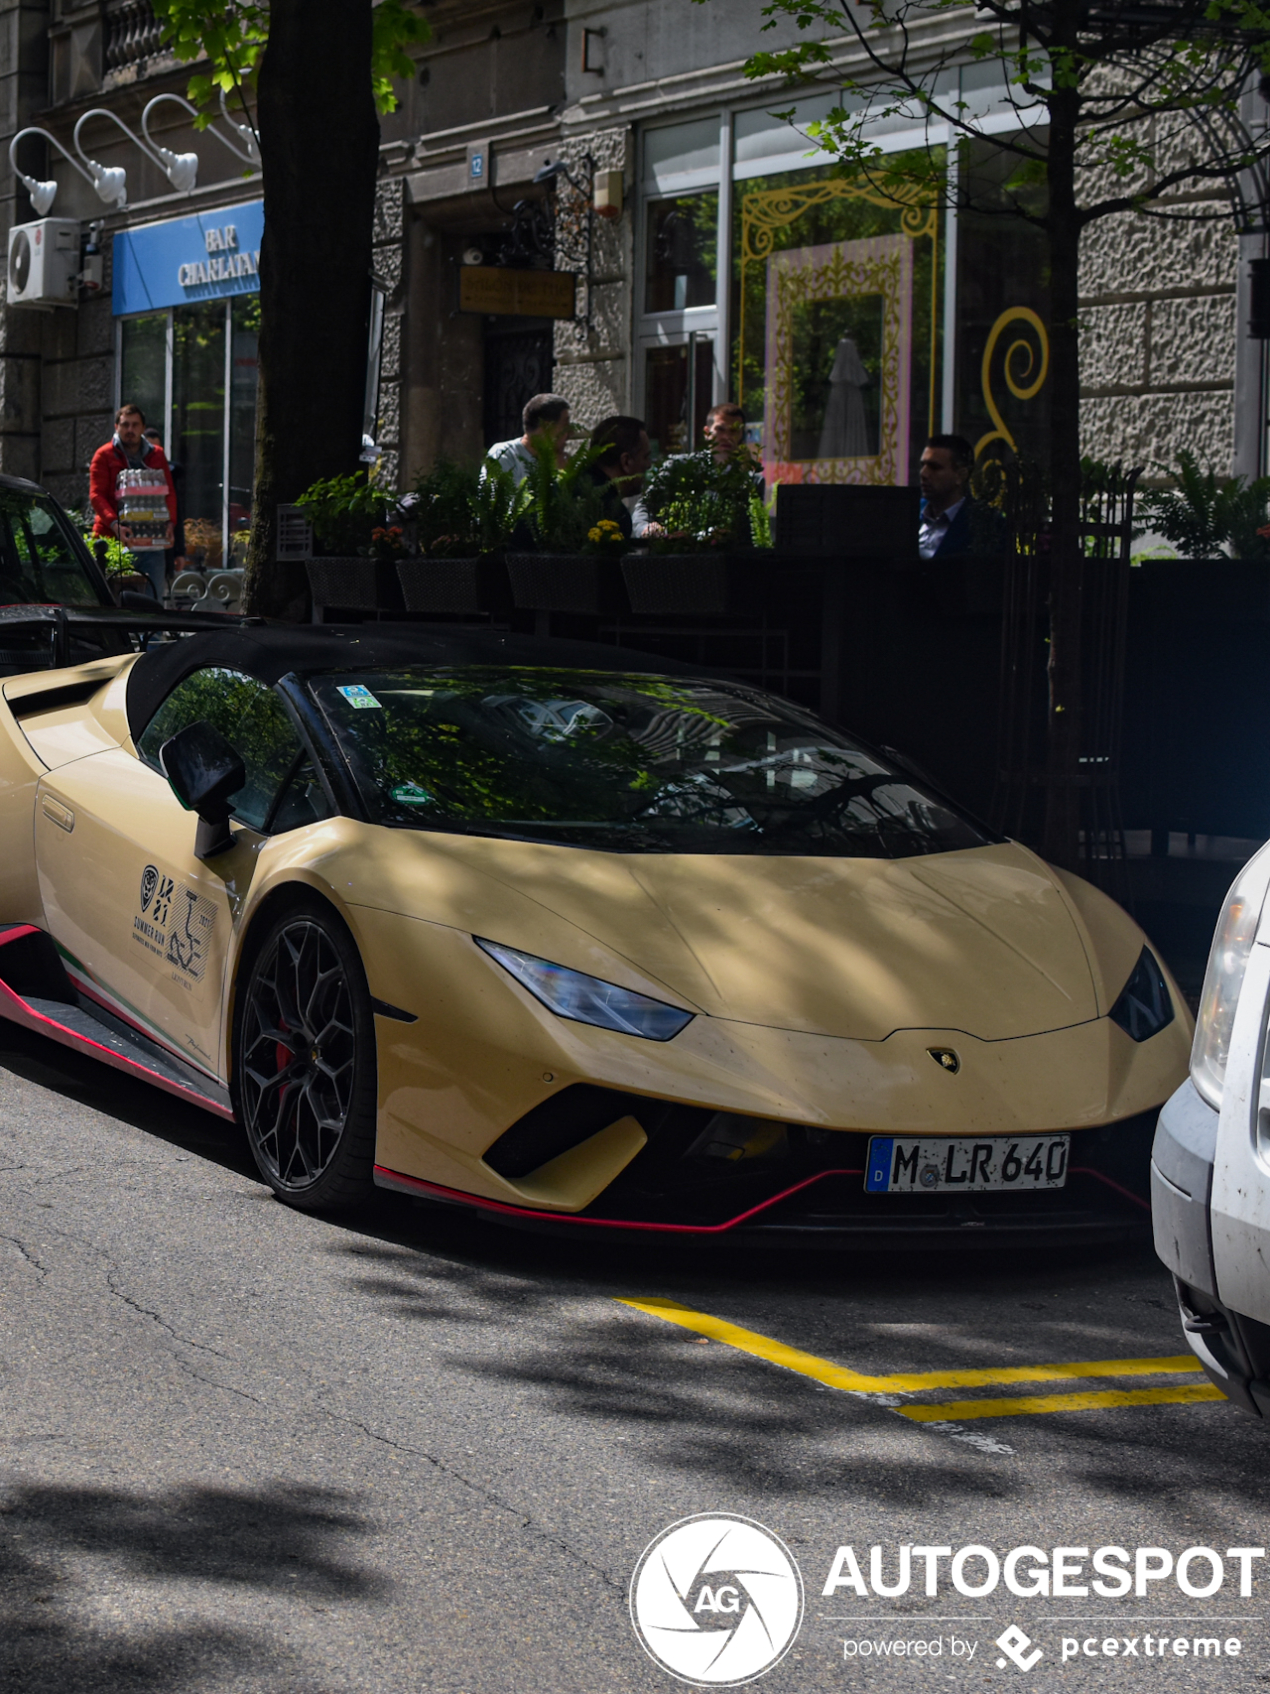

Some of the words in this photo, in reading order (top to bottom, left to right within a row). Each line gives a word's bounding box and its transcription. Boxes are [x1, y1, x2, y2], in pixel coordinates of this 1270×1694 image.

[472, 158, 482, 173] 12
[206, 225, 237, 252] BAR
[134, 916, 155, 940] SUMMER
[154, 930, 166, 946] RUN
[199, 914, 211, 929] 2021
[874, 1170, 883, 1182] D
[893, 1145, 920, 1184] M
[944, 1143, 993, 1183] LR
[1001, 1141, 1067, 1182] 640
